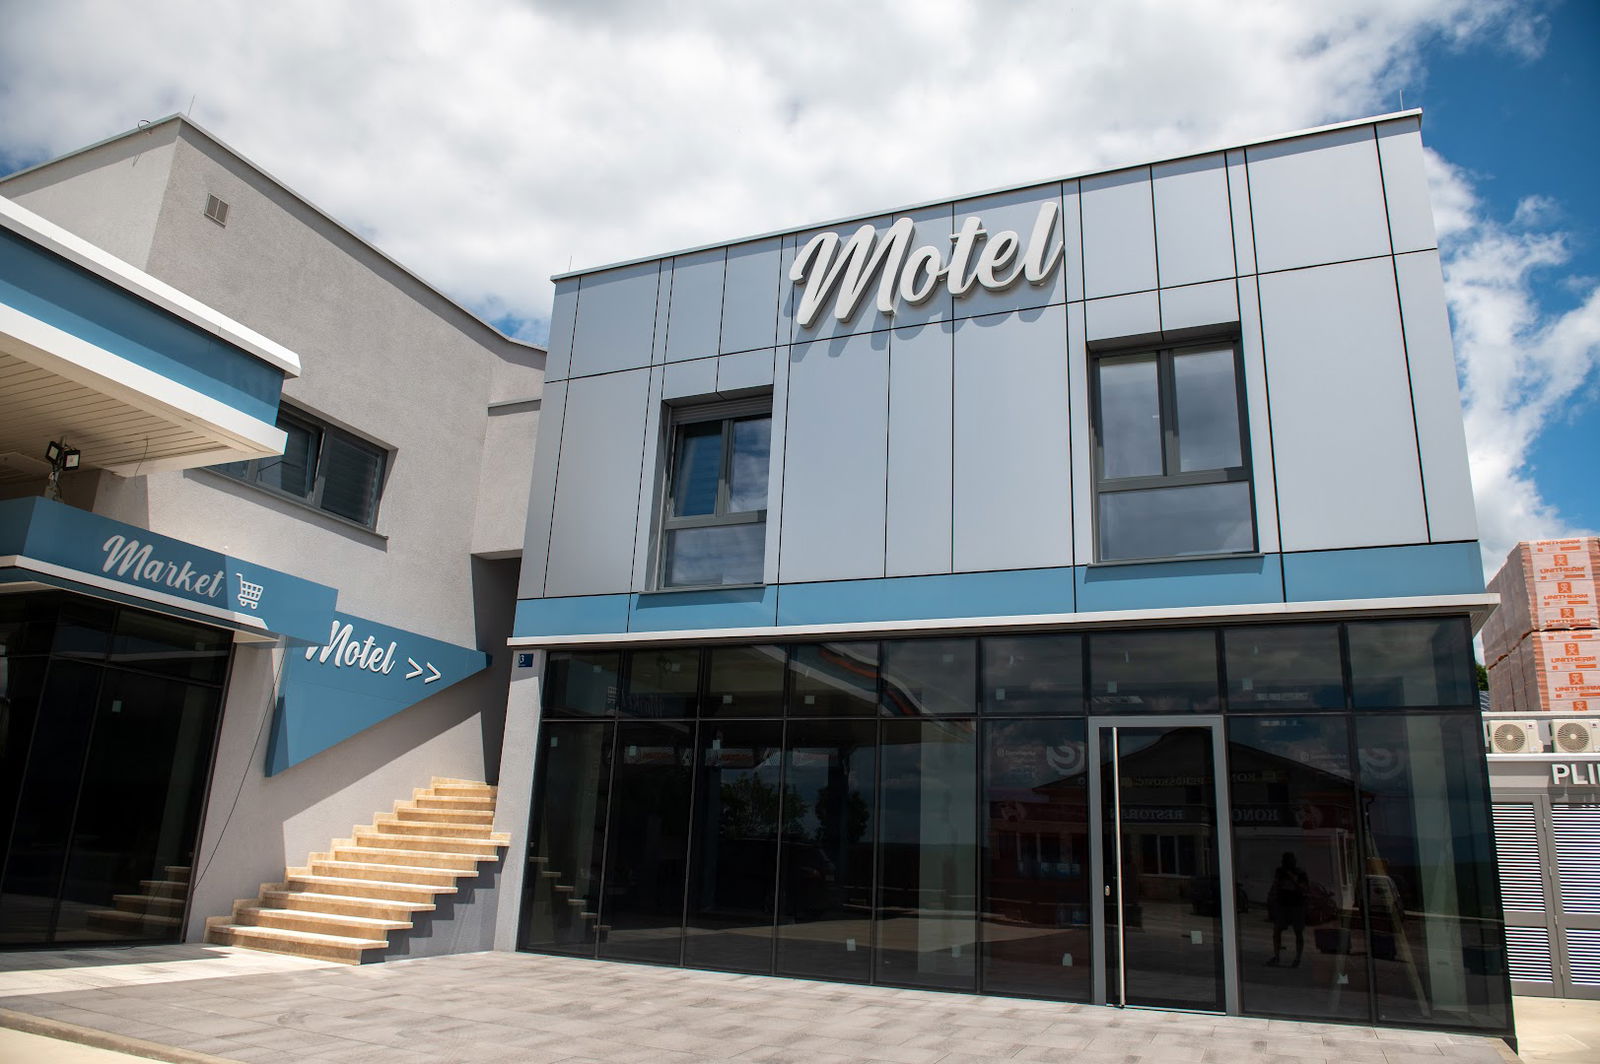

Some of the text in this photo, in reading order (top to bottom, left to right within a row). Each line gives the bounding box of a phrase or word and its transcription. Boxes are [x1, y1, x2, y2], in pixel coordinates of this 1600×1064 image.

[789, 201, 1065, 328] Motel
[103, 534, 224, 598] Market
[1539, 566, 1586, 575] UNITHERM
[1543, 593, 1589, 601] UNITHERM
[304, 620, 398, 675] Motel
[1551, 656, 1597, 664] UNITHERM
[1551, 763, 1600, 785] PLI
